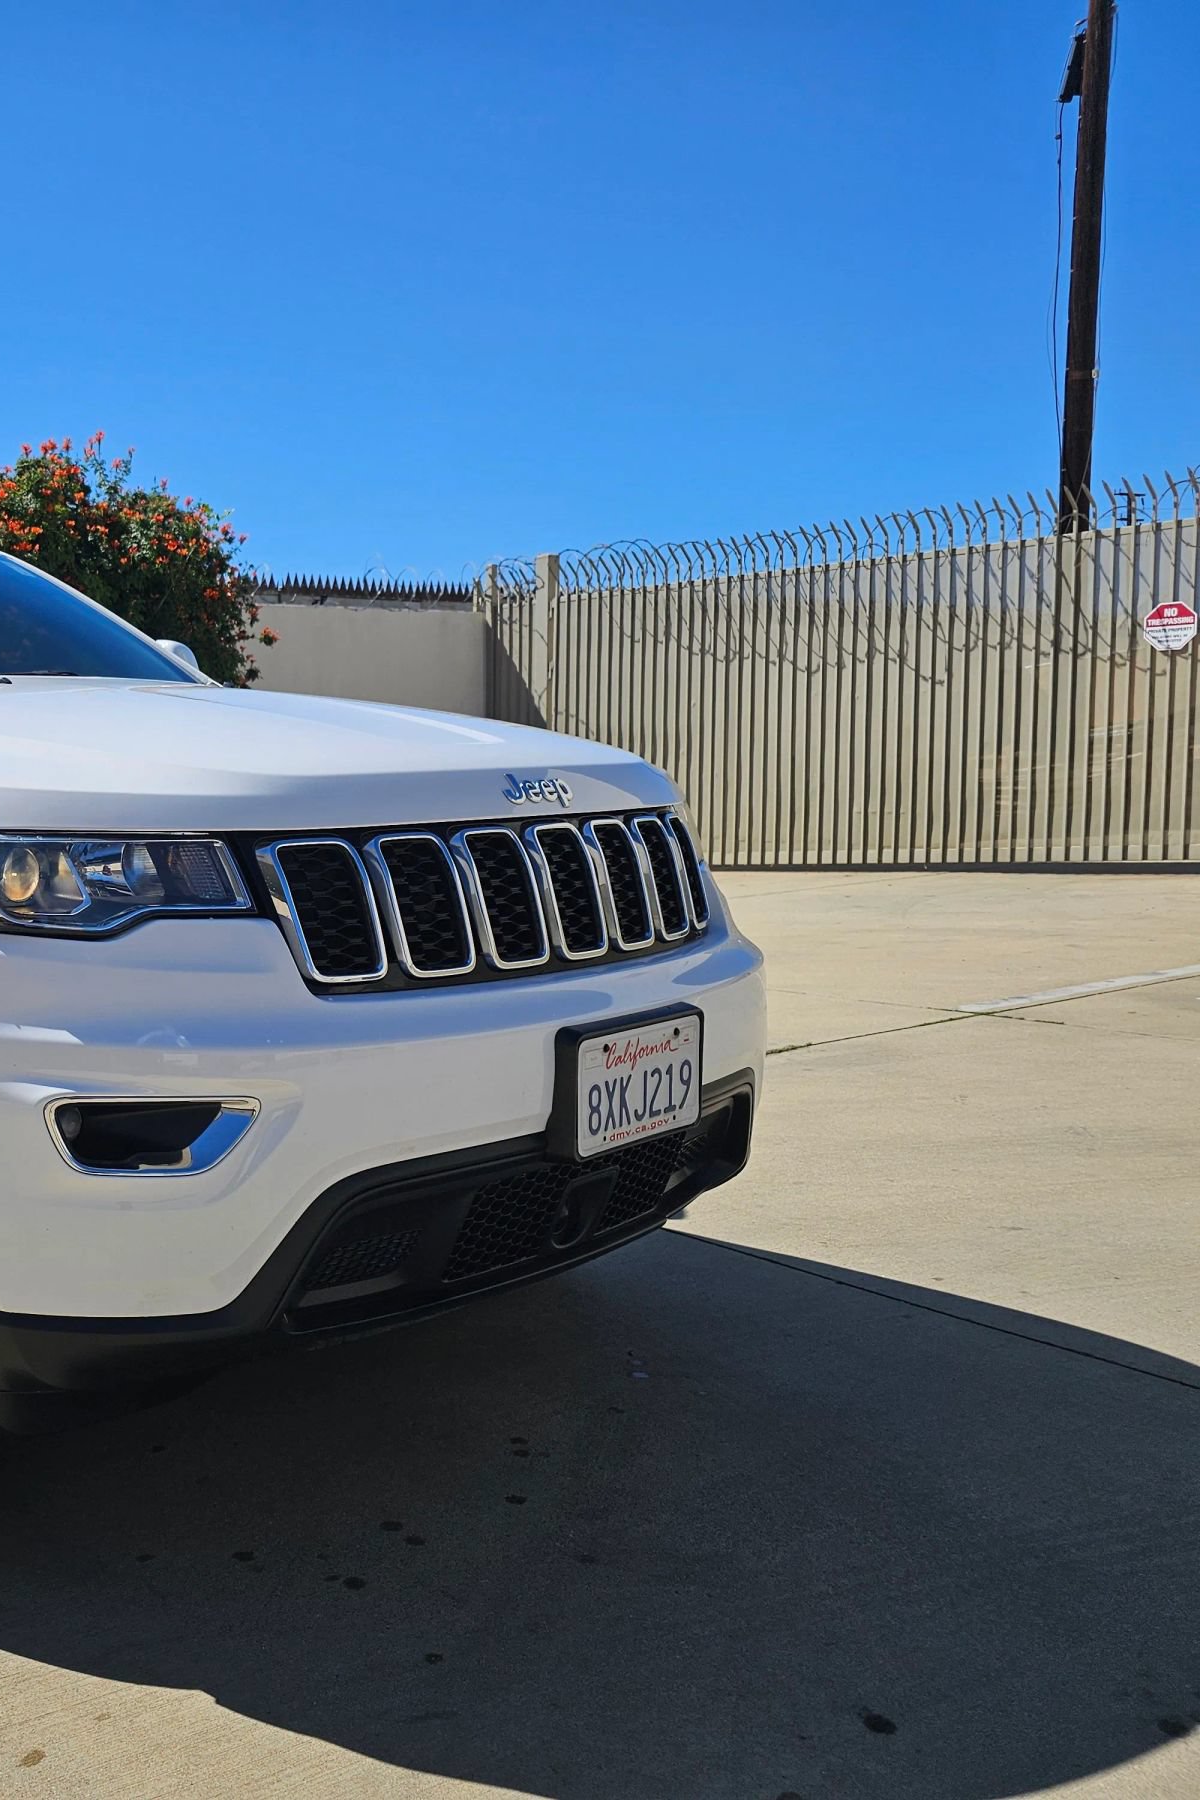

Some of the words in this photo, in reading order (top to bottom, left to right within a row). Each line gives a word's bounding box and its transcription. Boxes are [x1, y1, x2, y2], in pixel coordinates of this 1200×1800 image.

[1147, 615, 1194, 626] TRESPASSING
[1163, 607, 1178, 617] NO
[502, 773, 573, 808] Jeep
[605, 1037, 679, 1071] California
[588, 1059, 692, 1136] 8XKJ219
[609, 1117, 670, 1142] dmv.ca.gov
